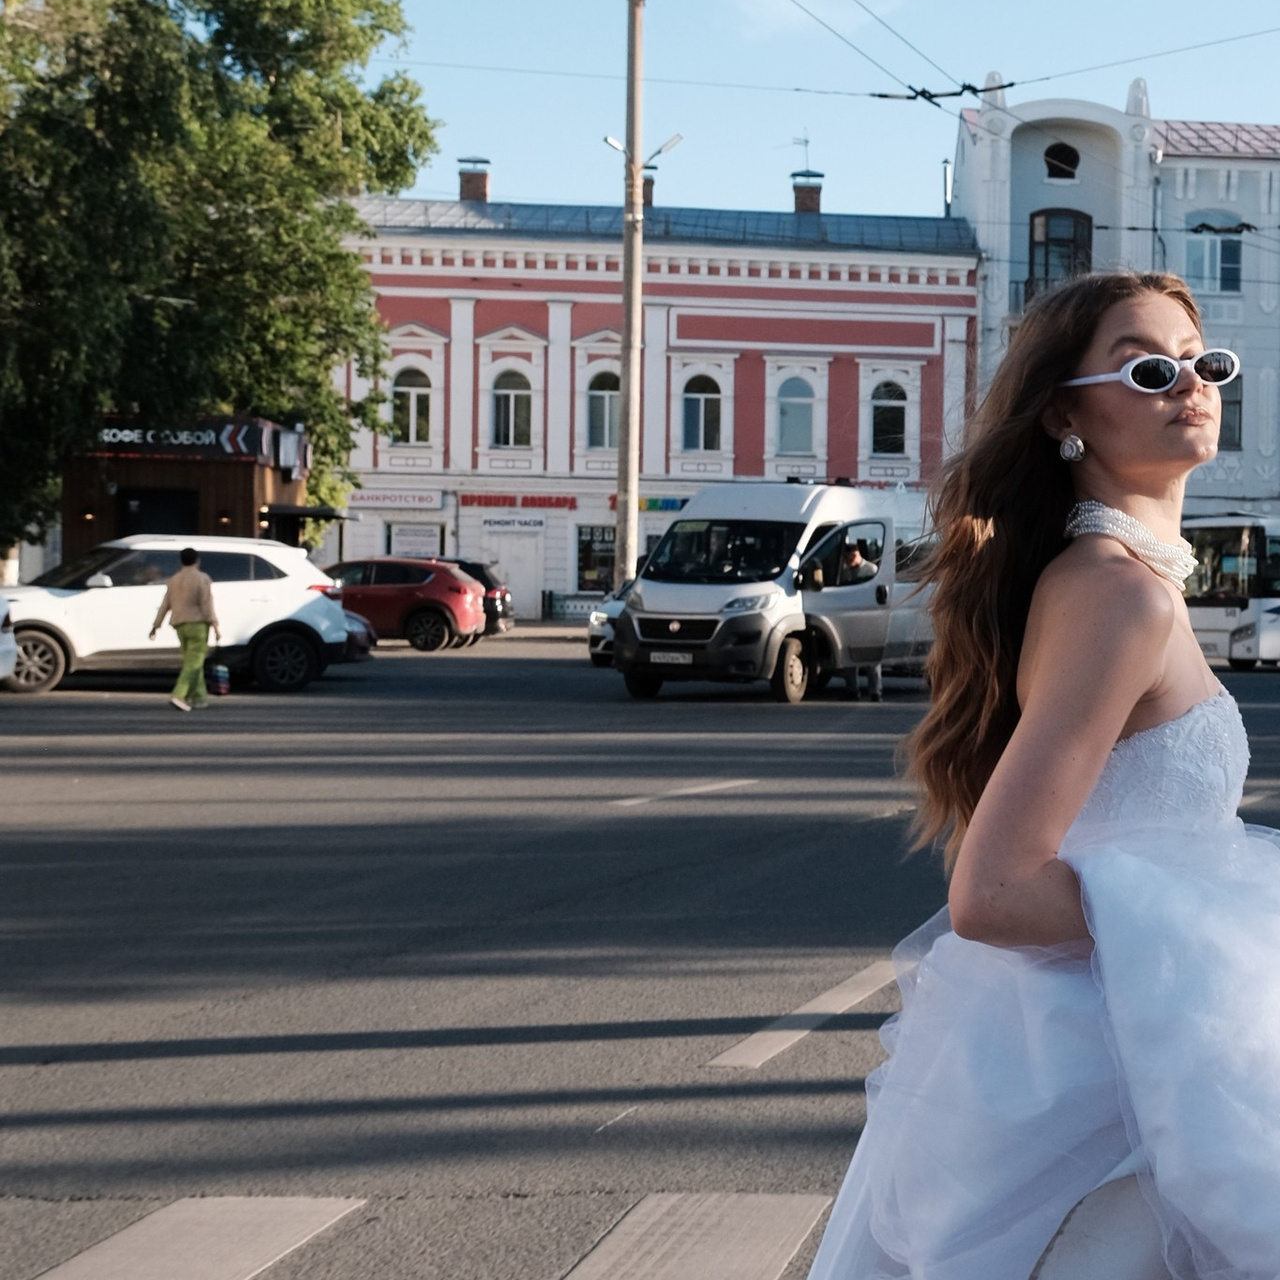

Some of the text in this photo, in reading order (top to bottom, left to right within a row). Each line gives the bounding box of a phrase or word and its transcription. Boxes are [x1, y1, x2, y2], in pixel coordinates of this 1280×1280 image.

[350, 493, 434, 503] БАНКРОТСТВО
[521, 496, 578, 510] ЛОМБАРД
[483, 519, 544, 527] РЕМОНТ ЧАСОВ
